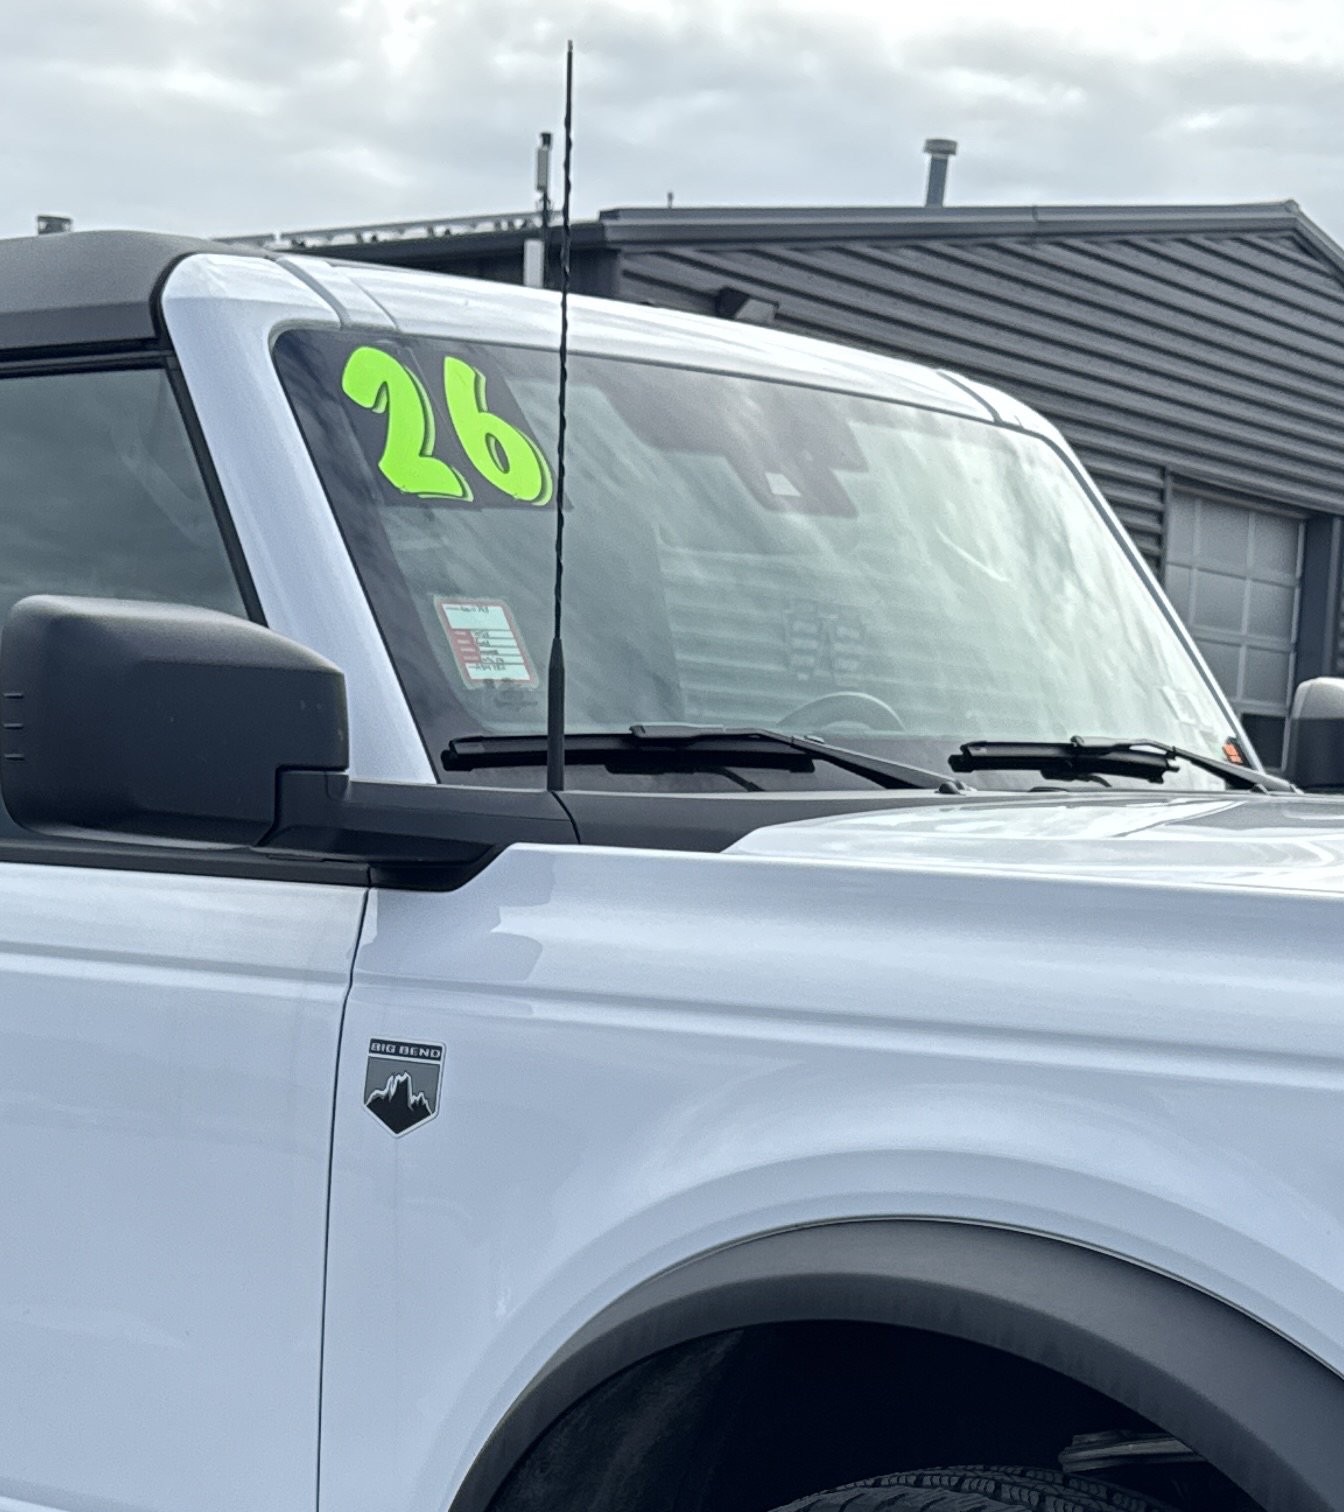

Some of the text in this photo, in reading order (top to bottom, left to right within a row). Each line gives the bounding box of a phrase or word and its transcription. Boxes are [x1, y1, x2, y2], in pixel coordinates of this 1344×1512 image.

[342, 346, 552, 506] 26
[370, 1042, 441, 1058] BIG BEND
